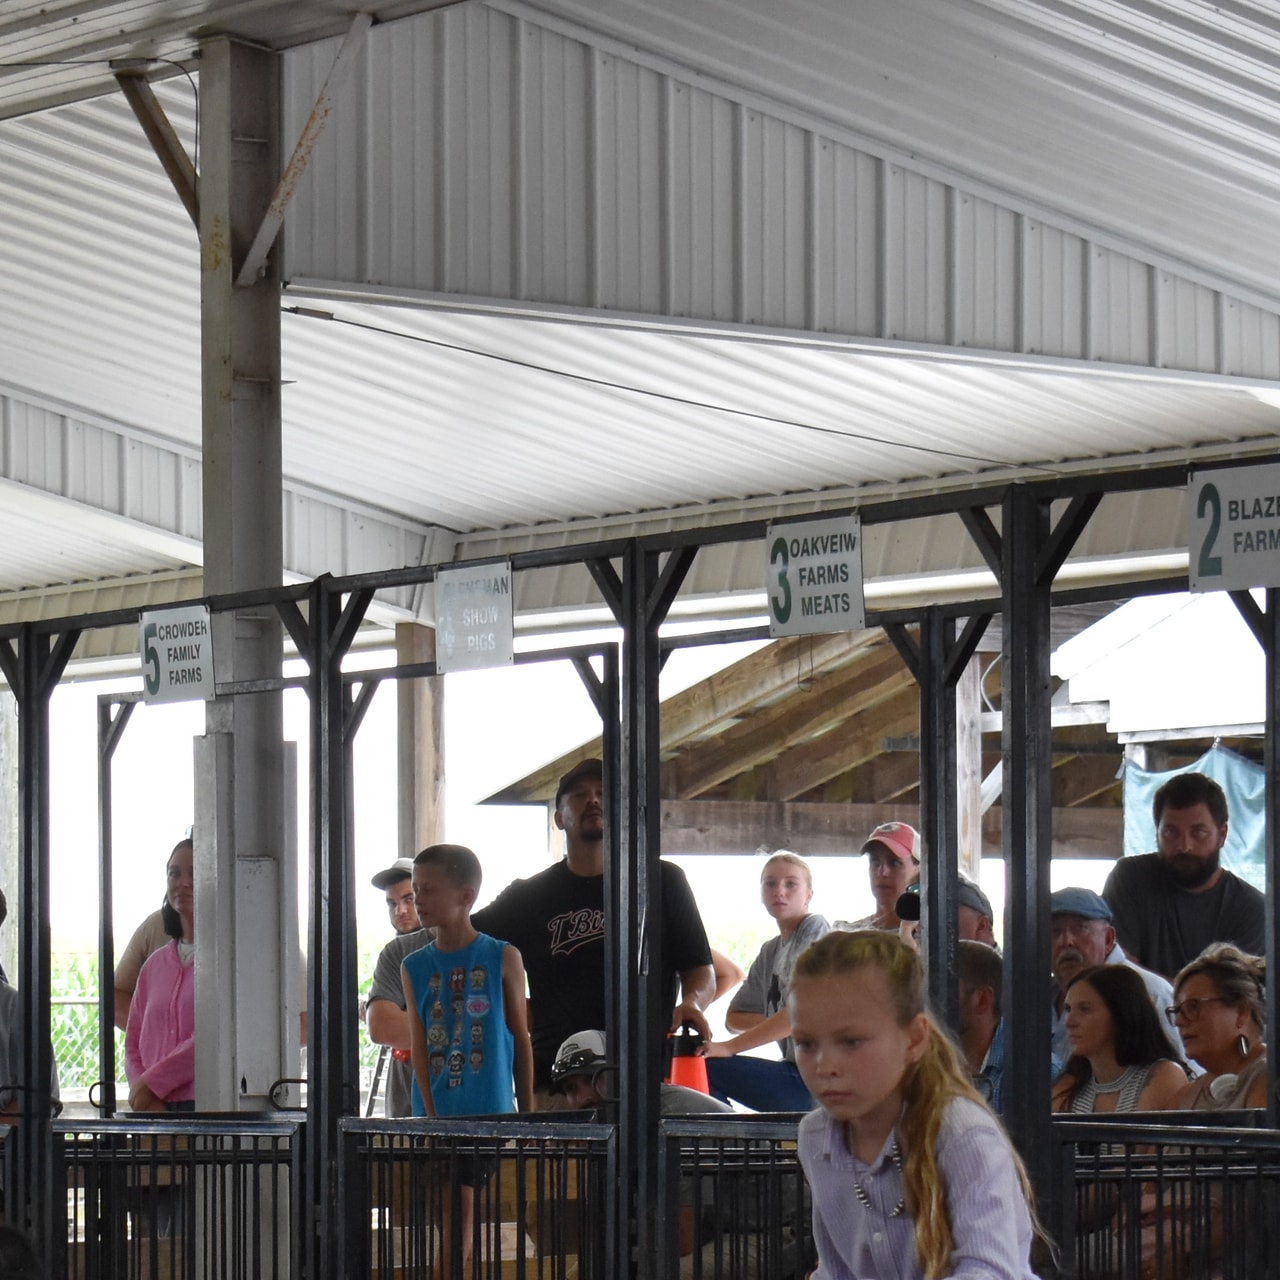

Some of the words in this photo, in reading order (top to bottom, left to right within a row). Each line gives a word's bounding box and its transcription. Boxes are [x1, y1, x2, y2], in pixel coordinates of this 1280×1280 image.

[1197, 482, 1222, 577] 2
[790, 532, 856, 558] OAKVEIW
[770, 537, 792, 625] 3
[799, 563, 849, 586] FARMS
[463, 605, 498, 626] SHOW
[801, 593, 850, 616] MEATS
[158, 620, 207, 640] CROWDER
[167, 644, 201, 662] FAMILY
[467, 633, 496, 651] PIGS
[144, 623, 160, 695] 5
[169, 667, 202, 685] FARMS
